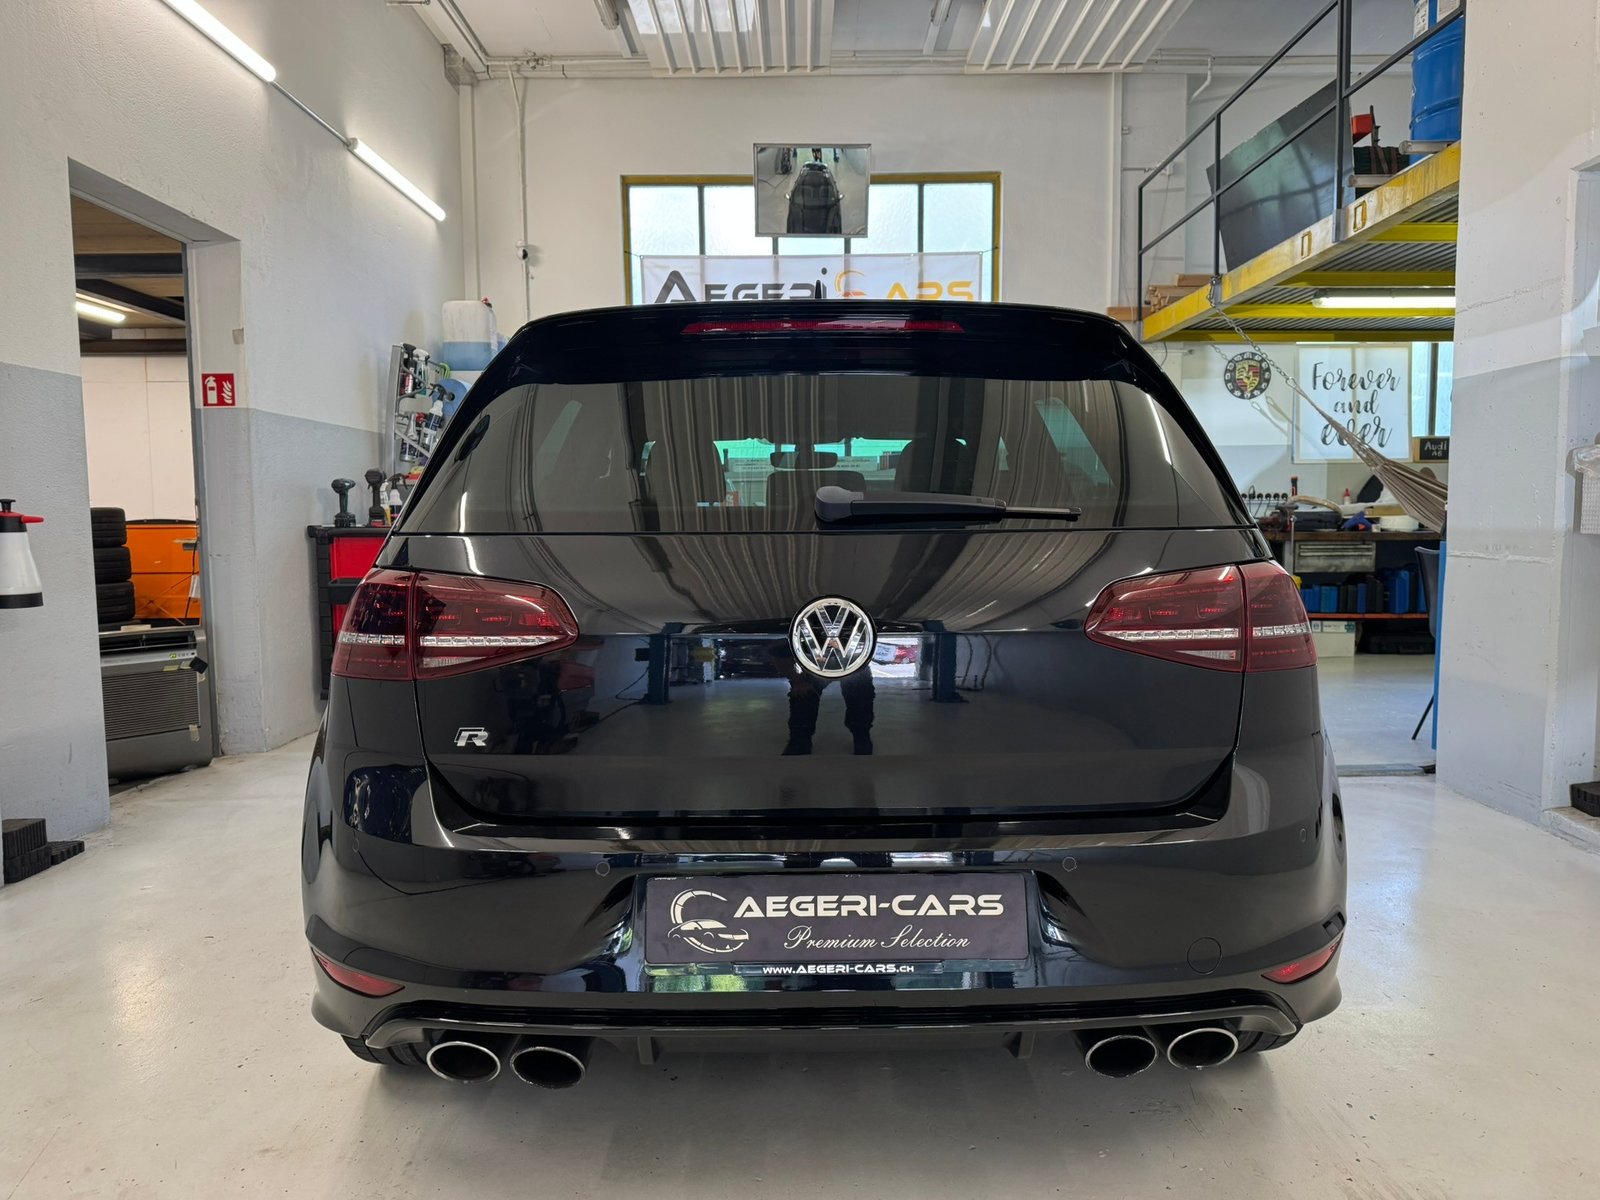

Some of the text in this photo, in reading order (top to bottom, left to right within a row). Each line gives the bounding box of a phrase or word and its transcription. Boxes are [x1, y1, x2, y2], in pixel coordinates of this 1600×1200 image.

[1312, 361, 1400, 392] Forever
[1333, 389, 1379, 414] and
[1424, 440, 1447, 451] Audi
[453, 727, 489, 747] R
[733, 894, 1004, 918] AEGERI-CARS
[783, 924, 971, 950] Premium Selection
